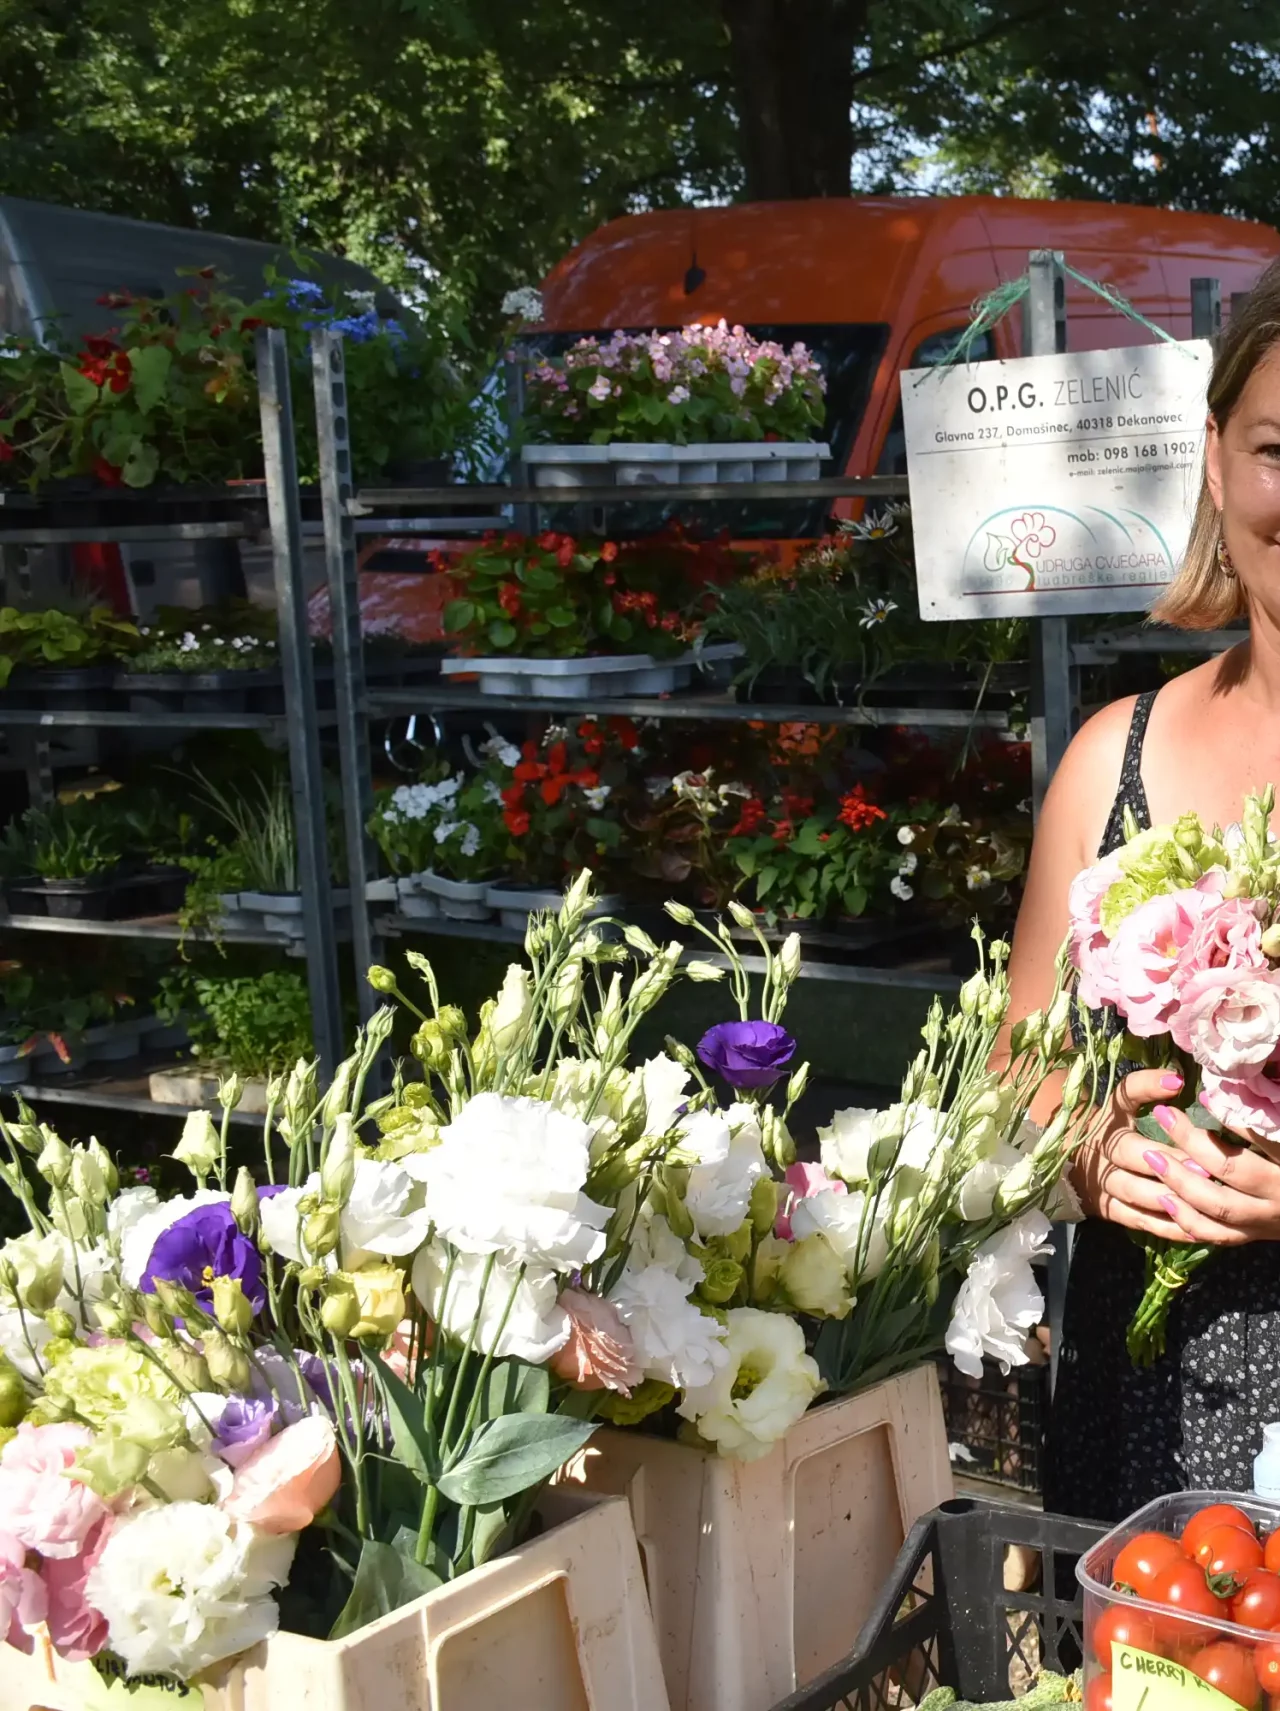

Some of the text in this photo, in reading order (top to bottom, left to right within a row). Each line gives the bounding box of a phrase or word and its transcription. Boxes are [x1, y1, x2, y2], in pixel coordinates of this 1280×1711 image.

[967, 367, 1143, 413] O.P.G. ZELENIĆ
[935, 413, 1183, 443] Glavna 237, Domašinec, 40318 Dekanovec
[1067, 441, 1195, 464] mob: 098 168 1902
[1036, 557, 1092, 574] UDRUGA
[1122, 568, 1168, 583] regije
[1120, 1652, 1186, 1687] CHERRY
